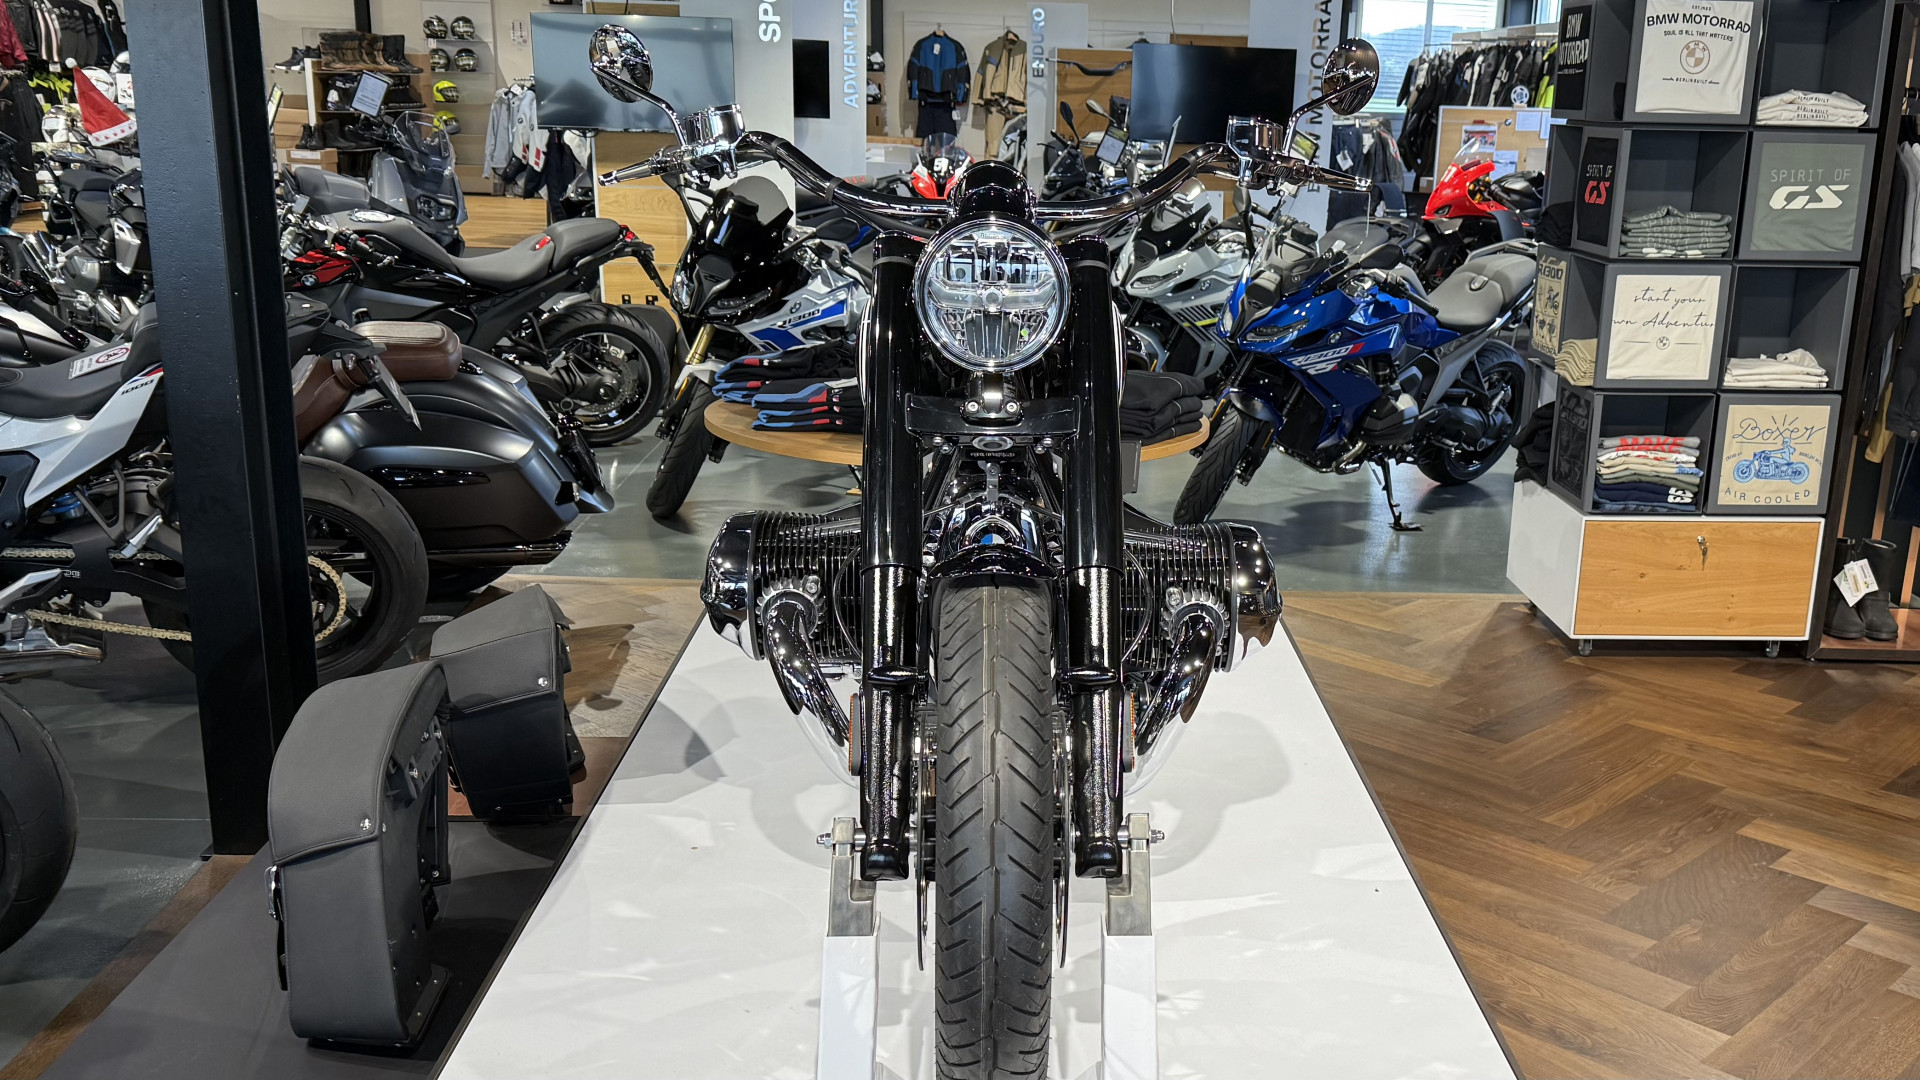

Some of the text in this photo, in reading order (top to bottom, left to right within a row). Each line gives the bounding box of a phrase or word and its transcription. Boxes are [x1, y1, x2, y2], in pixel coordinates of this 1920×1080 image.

[758, 0, 782, 43] SP
[1566, 13, 1583, 38] BMW
[1647, 12, 1751, 33] BMW MOTORRAD
[1032, 7, 1046, 78] ENDURO
[1709, 32, 1734, 42] MATTERS
[1605, 165, 1613, 178] OF
[1770, 168, 1853, 182] SPIRIT OF
[1584, 180, 1611, 205] GS
[1768, 184, 1850, 210] GS
[1633, 286, 1706, 310] start your
[1287, 344, 1354, 366] R1300
[120, 379, 154, 396] 1000
[1732, 417, 1826, 441] Boxer
[1724, 487, 1811, 504] AIR COOLED
